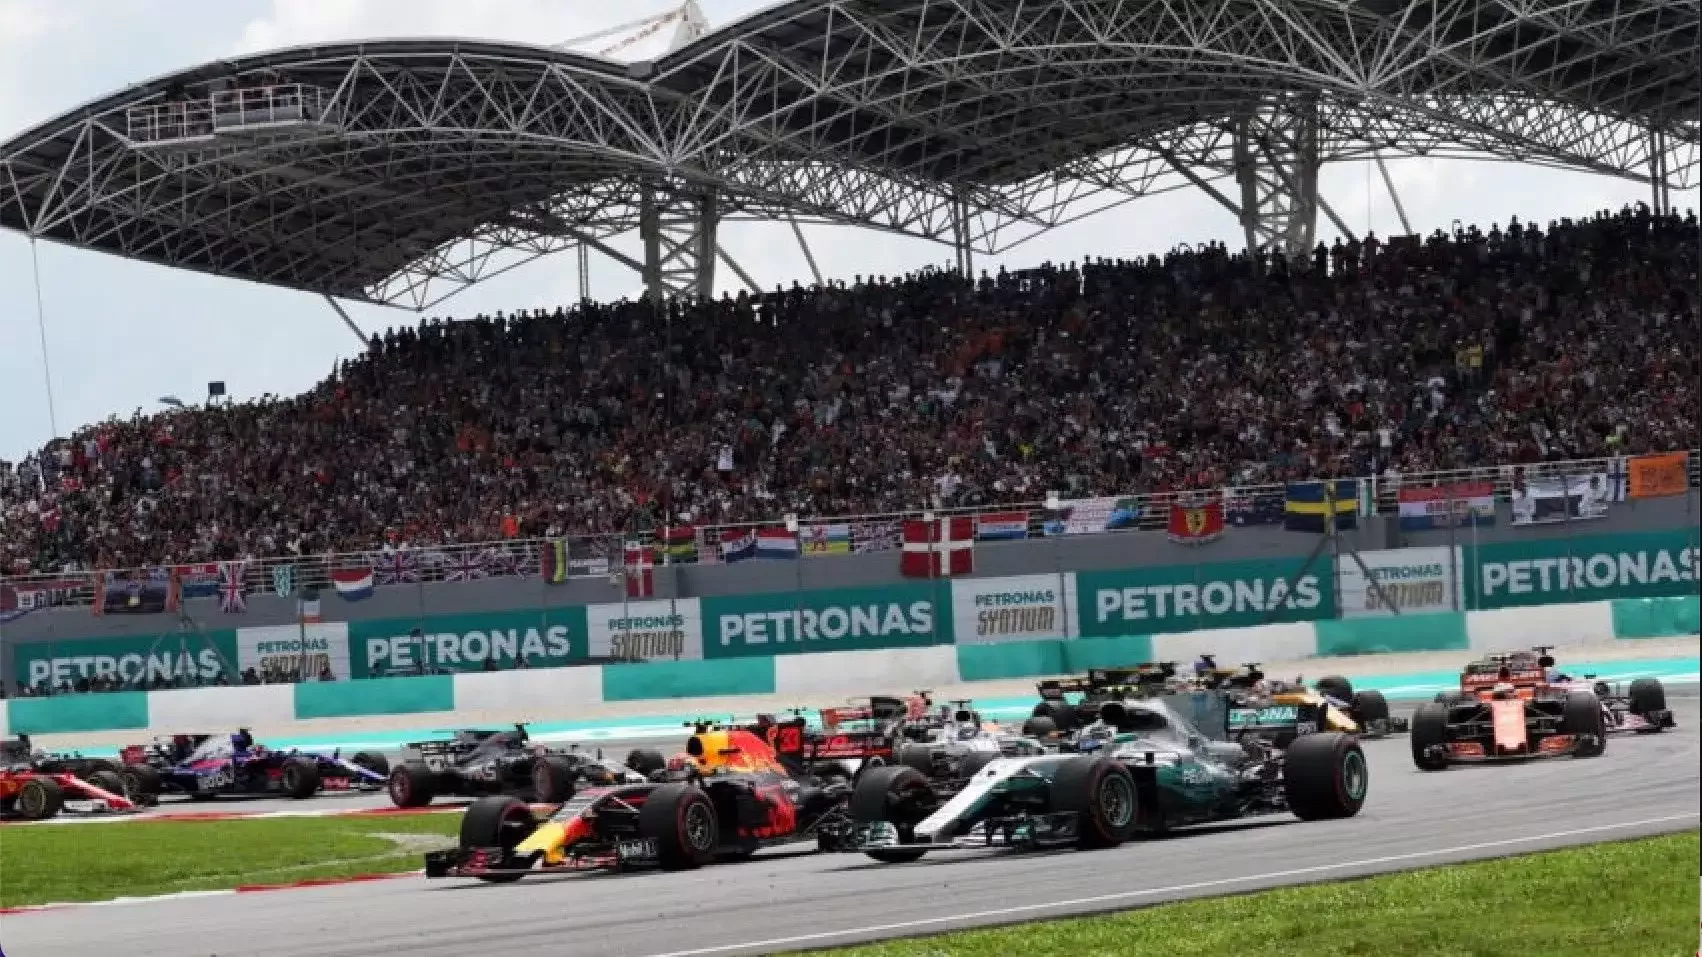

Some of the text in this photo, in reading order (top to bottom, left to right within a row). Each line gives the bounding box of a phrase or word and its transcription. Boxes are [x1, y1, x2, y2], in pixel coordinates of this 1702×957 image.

[1364, 563, 1443, 580] ETRONAS
[1483, 547, 1699, 596] PETRONAS
[976, 590, 1055, 606] PETRONAS
[1097, 576, 1321, 622] PETRONAS
[720, 602, 933, 646] PETRONAS
[367, 626, 570, 668] PETRONAS
[29, 649, 220, 688] PETRONAS
